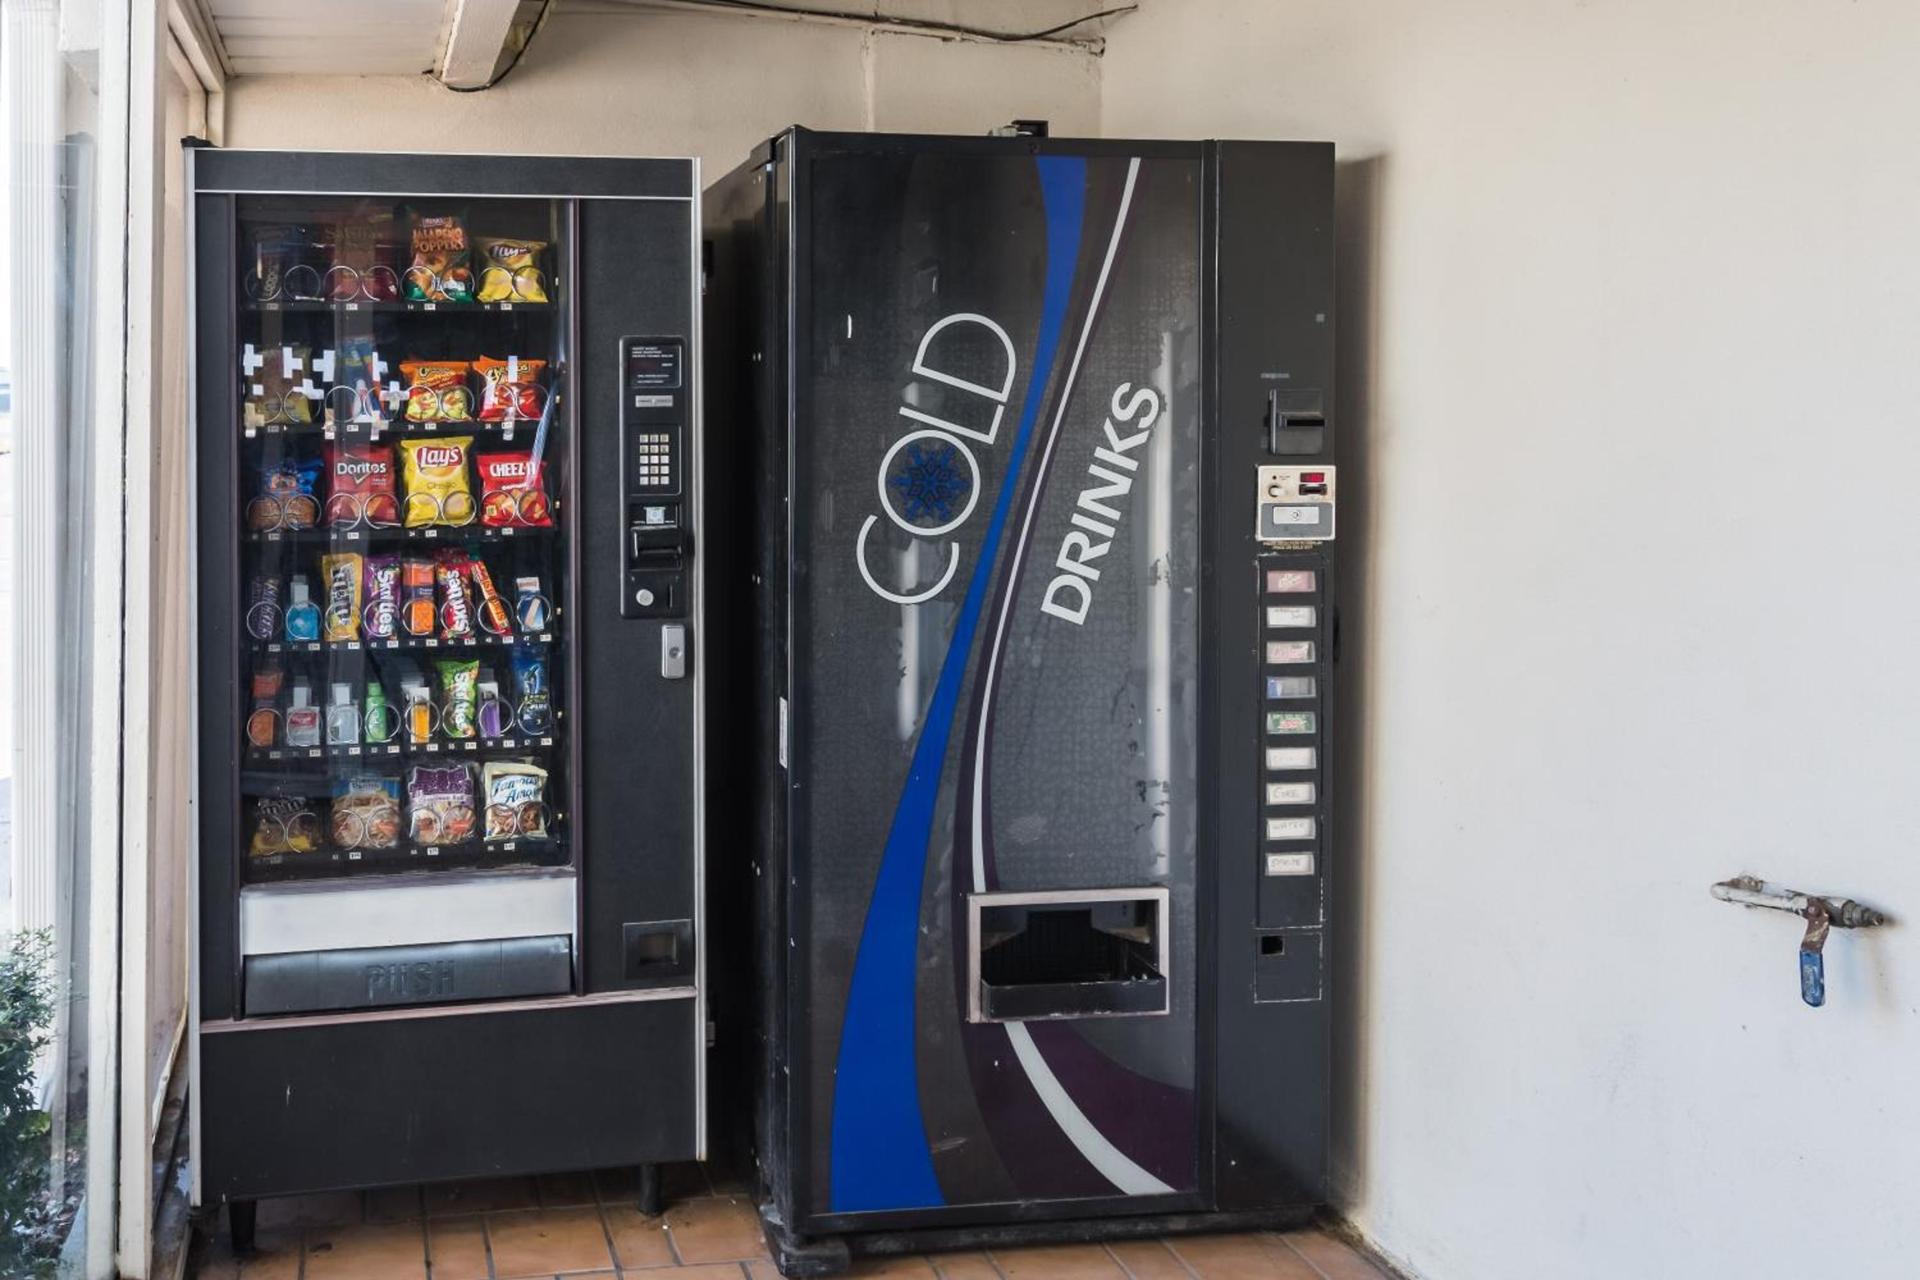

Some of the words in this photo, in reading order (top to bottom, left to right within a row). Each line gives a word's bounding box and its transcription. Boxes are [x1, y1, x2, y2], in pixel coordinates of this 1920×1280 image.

[336, 461, 387, 475] Doritos
[856, 312, 1016, 604] COLD
[1040, 382, 1160, 625] DRINKS
[367, 960, 456, 998] PUSH
